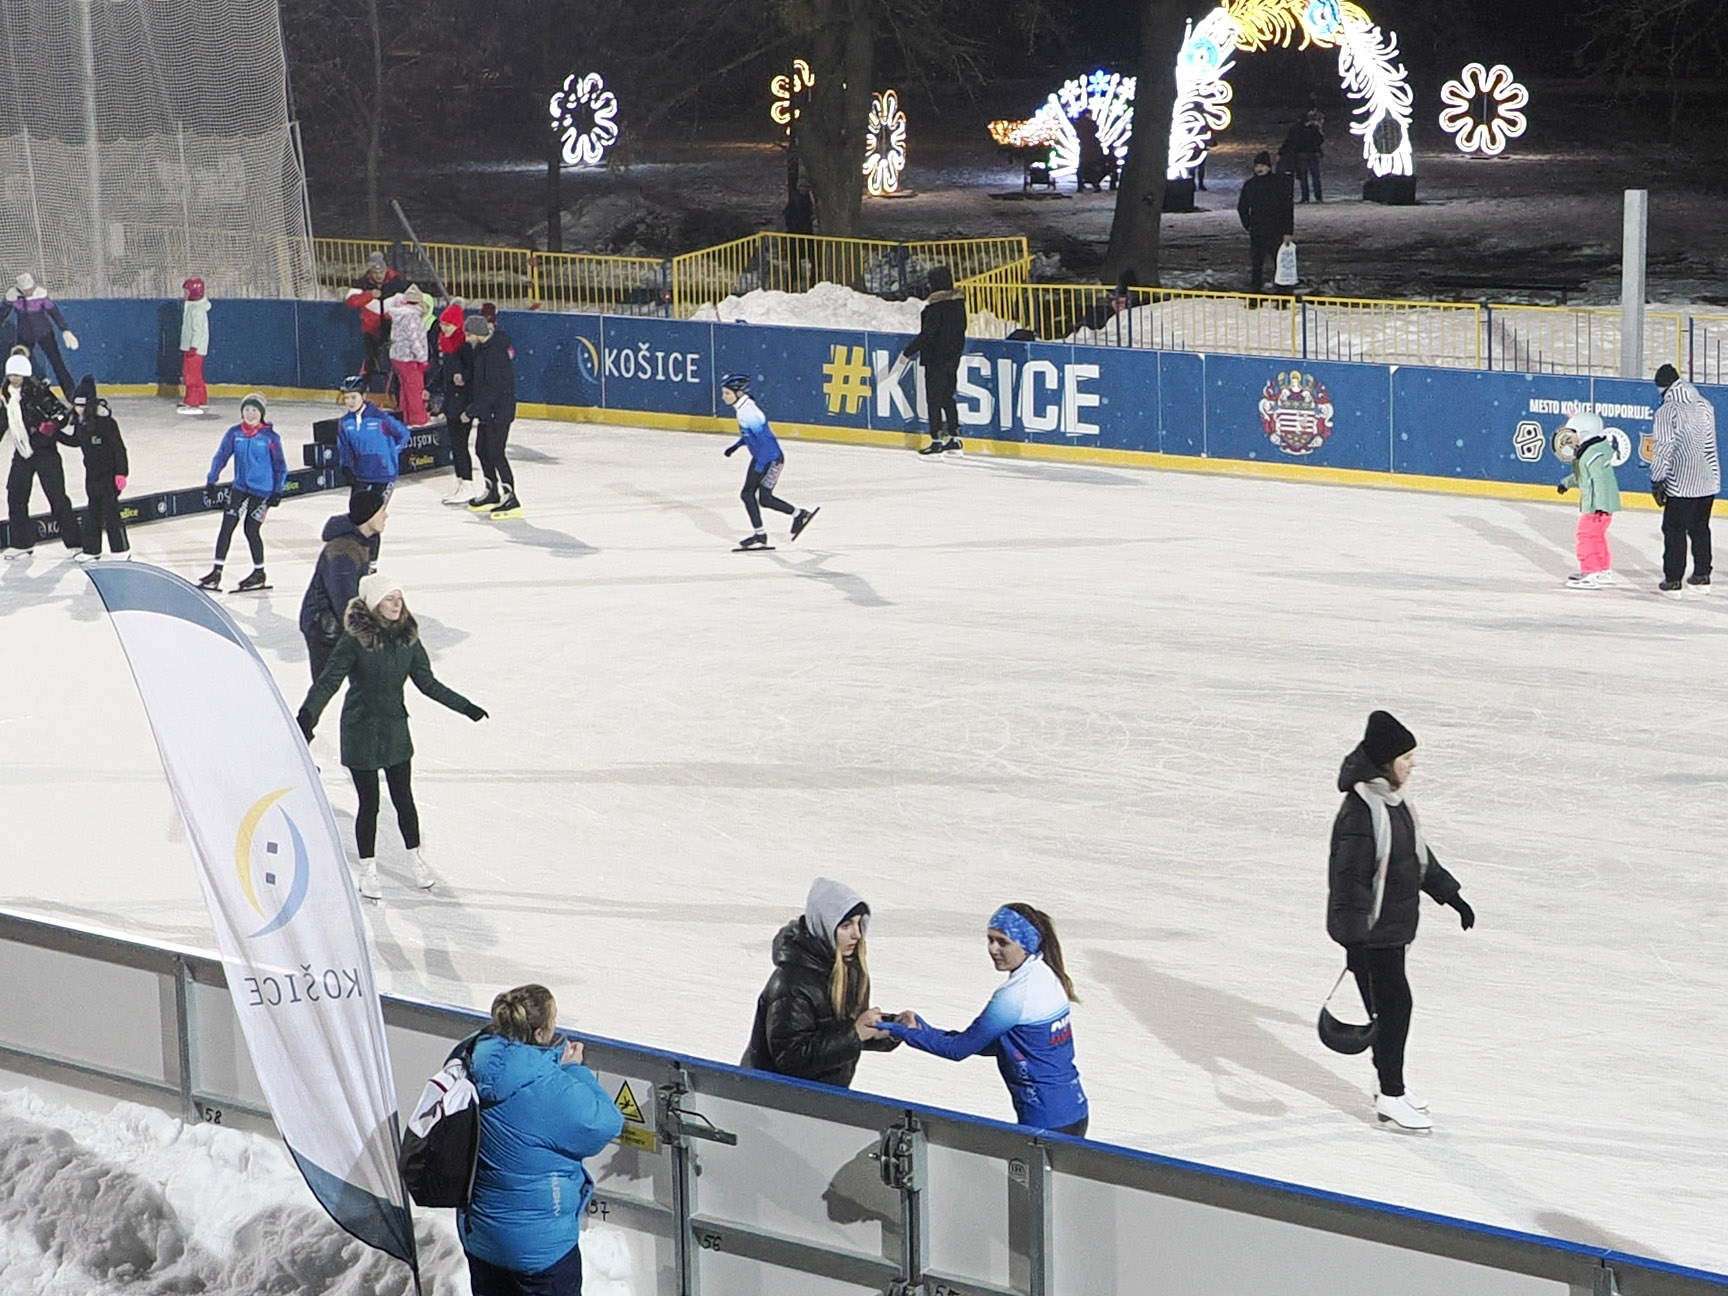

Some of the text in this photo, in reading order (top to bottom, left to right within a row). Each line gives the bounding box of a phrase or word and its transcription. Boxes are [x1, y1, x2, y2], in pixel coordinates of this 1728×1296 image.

[604, 342, 700, 383] KOŠICE
[822, 344, 1100, 436] #KSICE
[1529, 398, 1559, 414] MESTO
[1595, 402, 1654, 420] PODPORUJE:
[204, 1107, 222, 1124] 58
[589, 1199, 610, 1221] 57
[703, 1234, 721, 1251] 56
